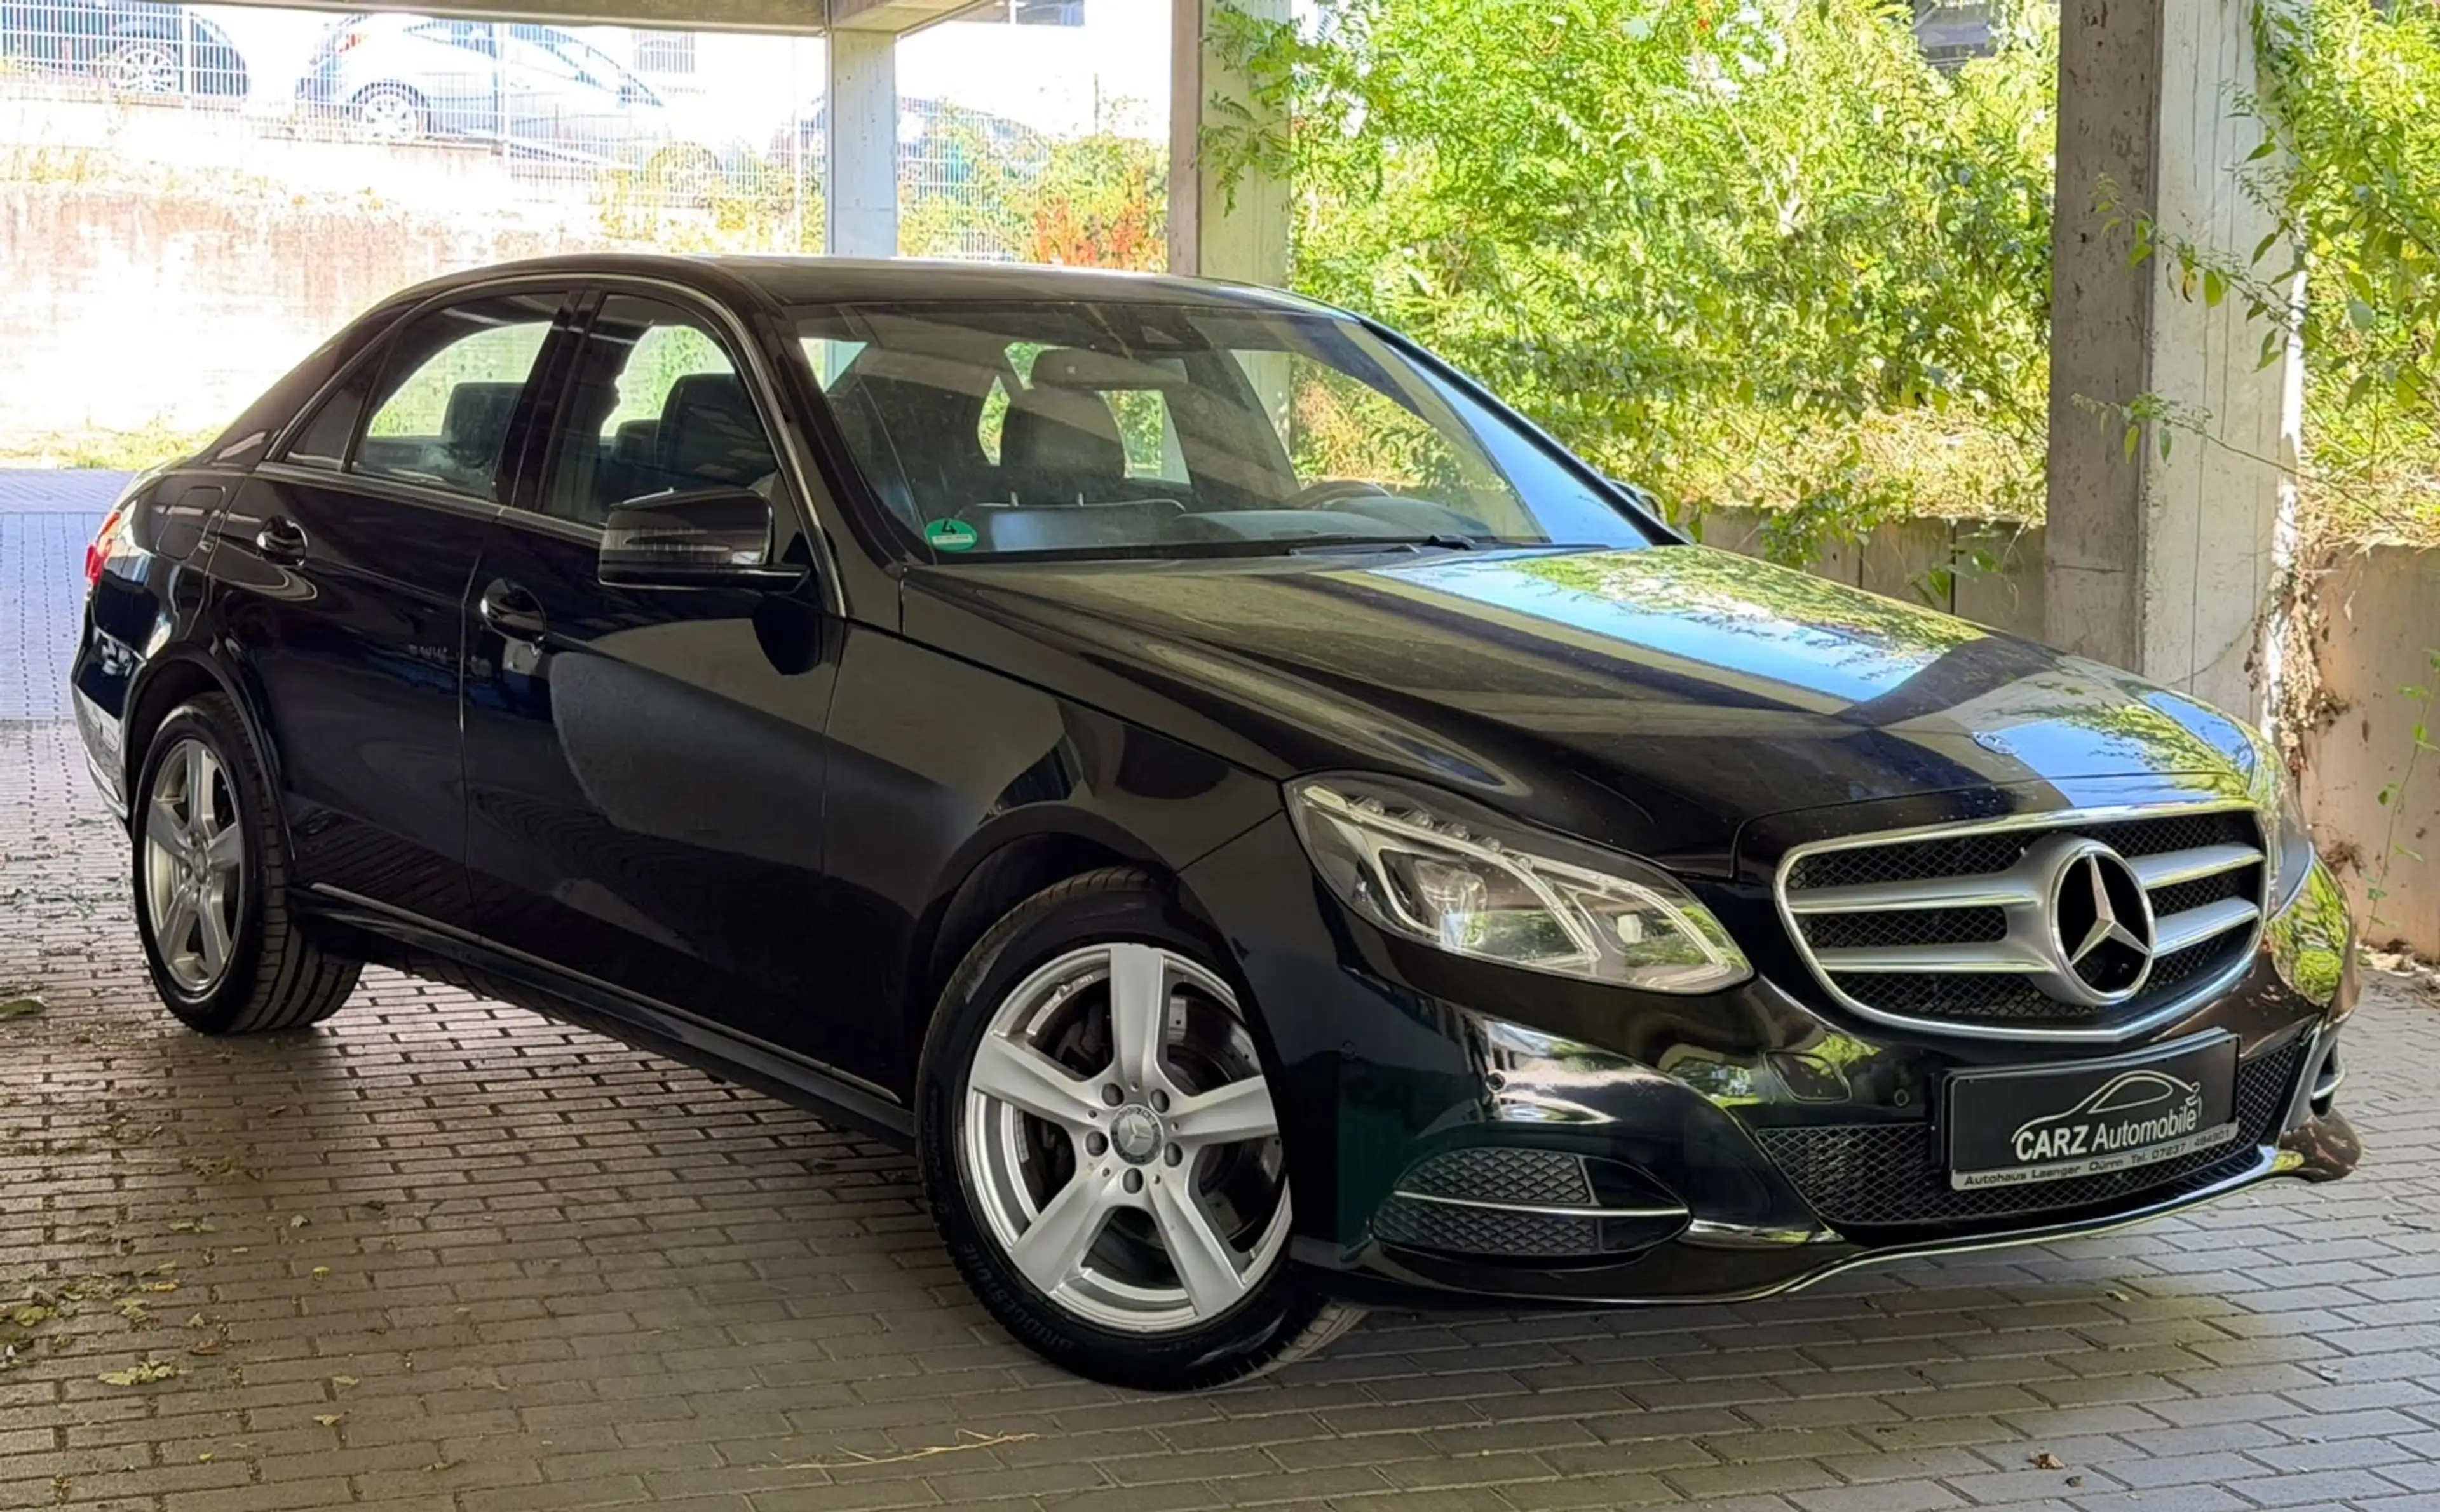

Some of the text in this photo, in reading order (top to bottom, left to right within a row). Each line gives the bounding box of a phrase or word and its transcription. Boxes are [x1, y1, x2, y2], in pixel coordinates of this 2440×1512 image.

[2016, 1105, 2197, 1161] CARZ Automobile
[1963, 1170, 2027, 1186] Autohaus
